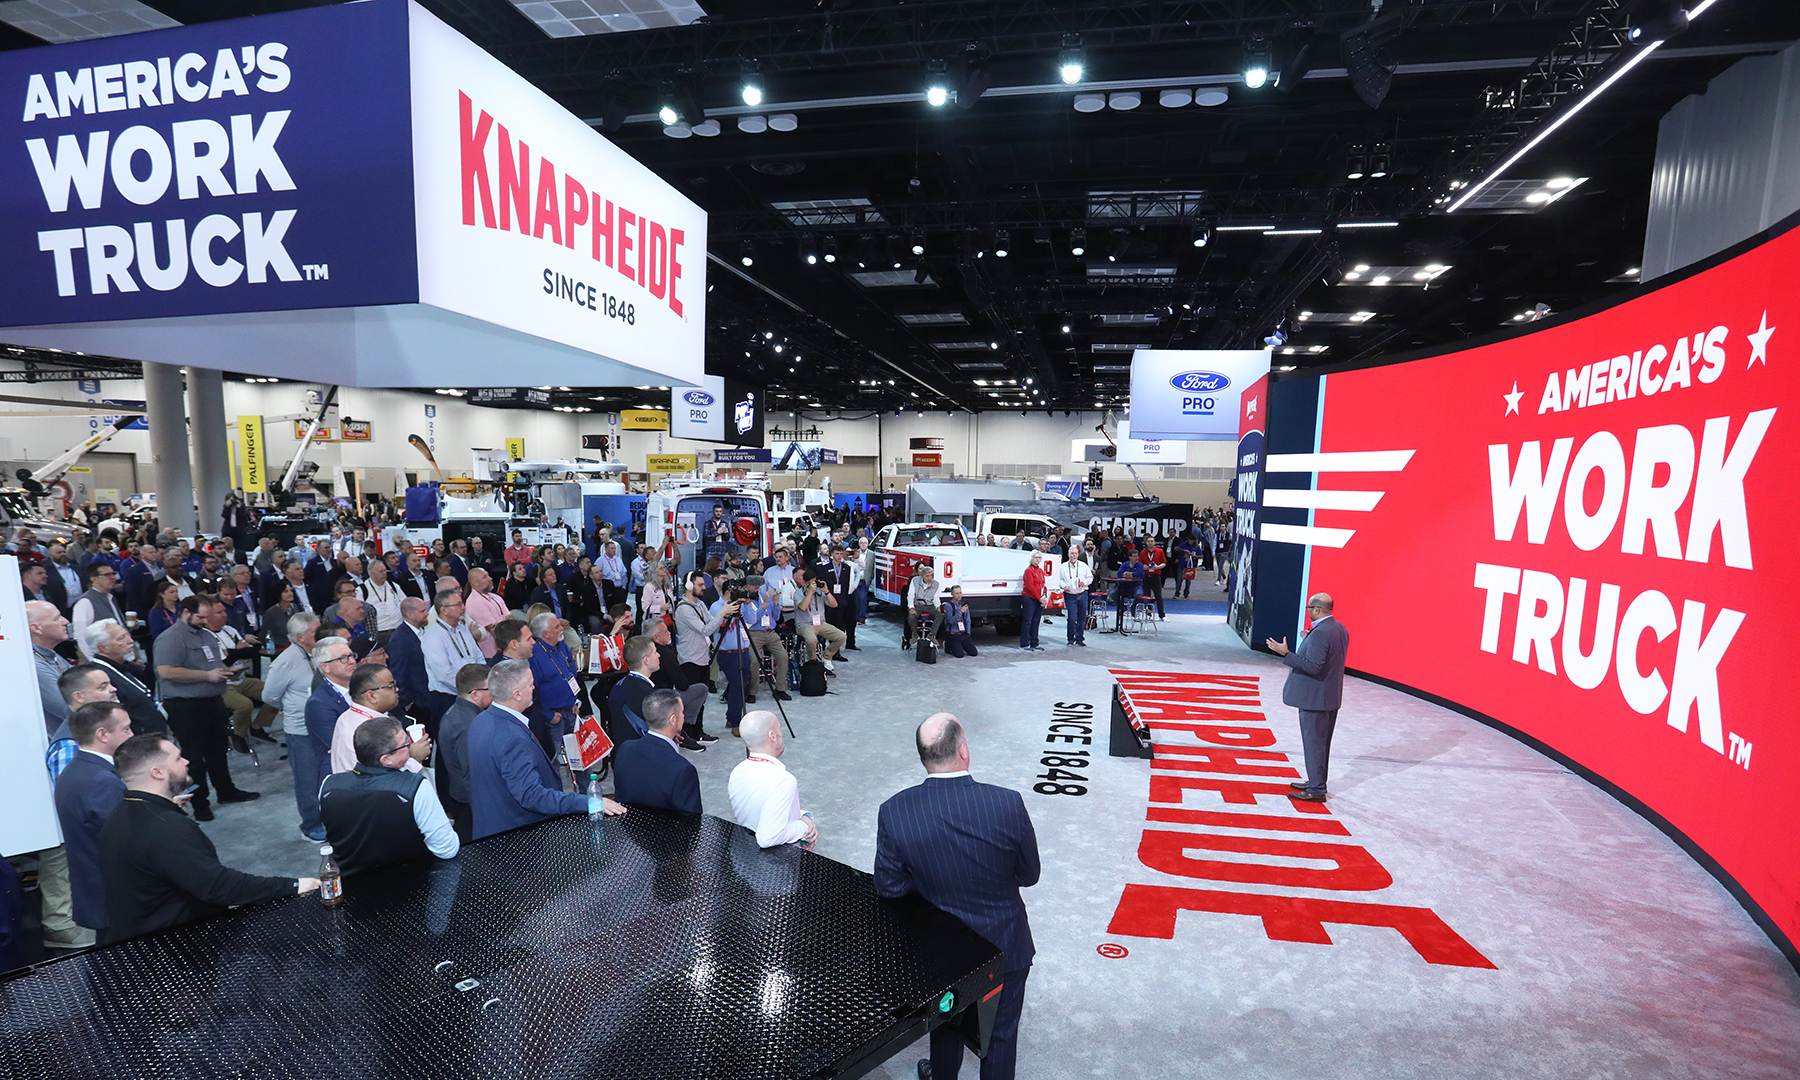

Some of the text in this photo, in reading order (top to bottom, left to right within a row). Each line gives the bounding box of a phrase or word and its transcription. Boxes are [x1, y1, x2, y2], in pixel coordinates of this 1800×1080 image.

[23, 42, 291, 121] AMERICA'S
[25, 109, 297, 212] WORK
[458, 88, 685, 319] KNAPHEIDE
[37, 209, 303, 297] TRUCK
[543, 268, 636, 326] SINCE 1848
[1181, 373, 1218, 389] Ford
[1183, 398, 1215, 409] PRO
[1537, 326, 1729, 415] AMERICA'S
[690, 409, 708, 419] PRO
[245, 423, 257, 485] PALFINGER
[1088, 472, 1102, 487] 65
[1238, 471, 1258, 503] WORK
[1488, 407, 1778, 570] WORK
[630, 501, 647, 509] REDU
[1162, 518, 1188, 538] UP
[1474, 562, 1725, 755] TRUCK
[1033, 701, 1094, 797] SINCE 1848
[1107, 668, 1500, 970] KNAPHEIDE
